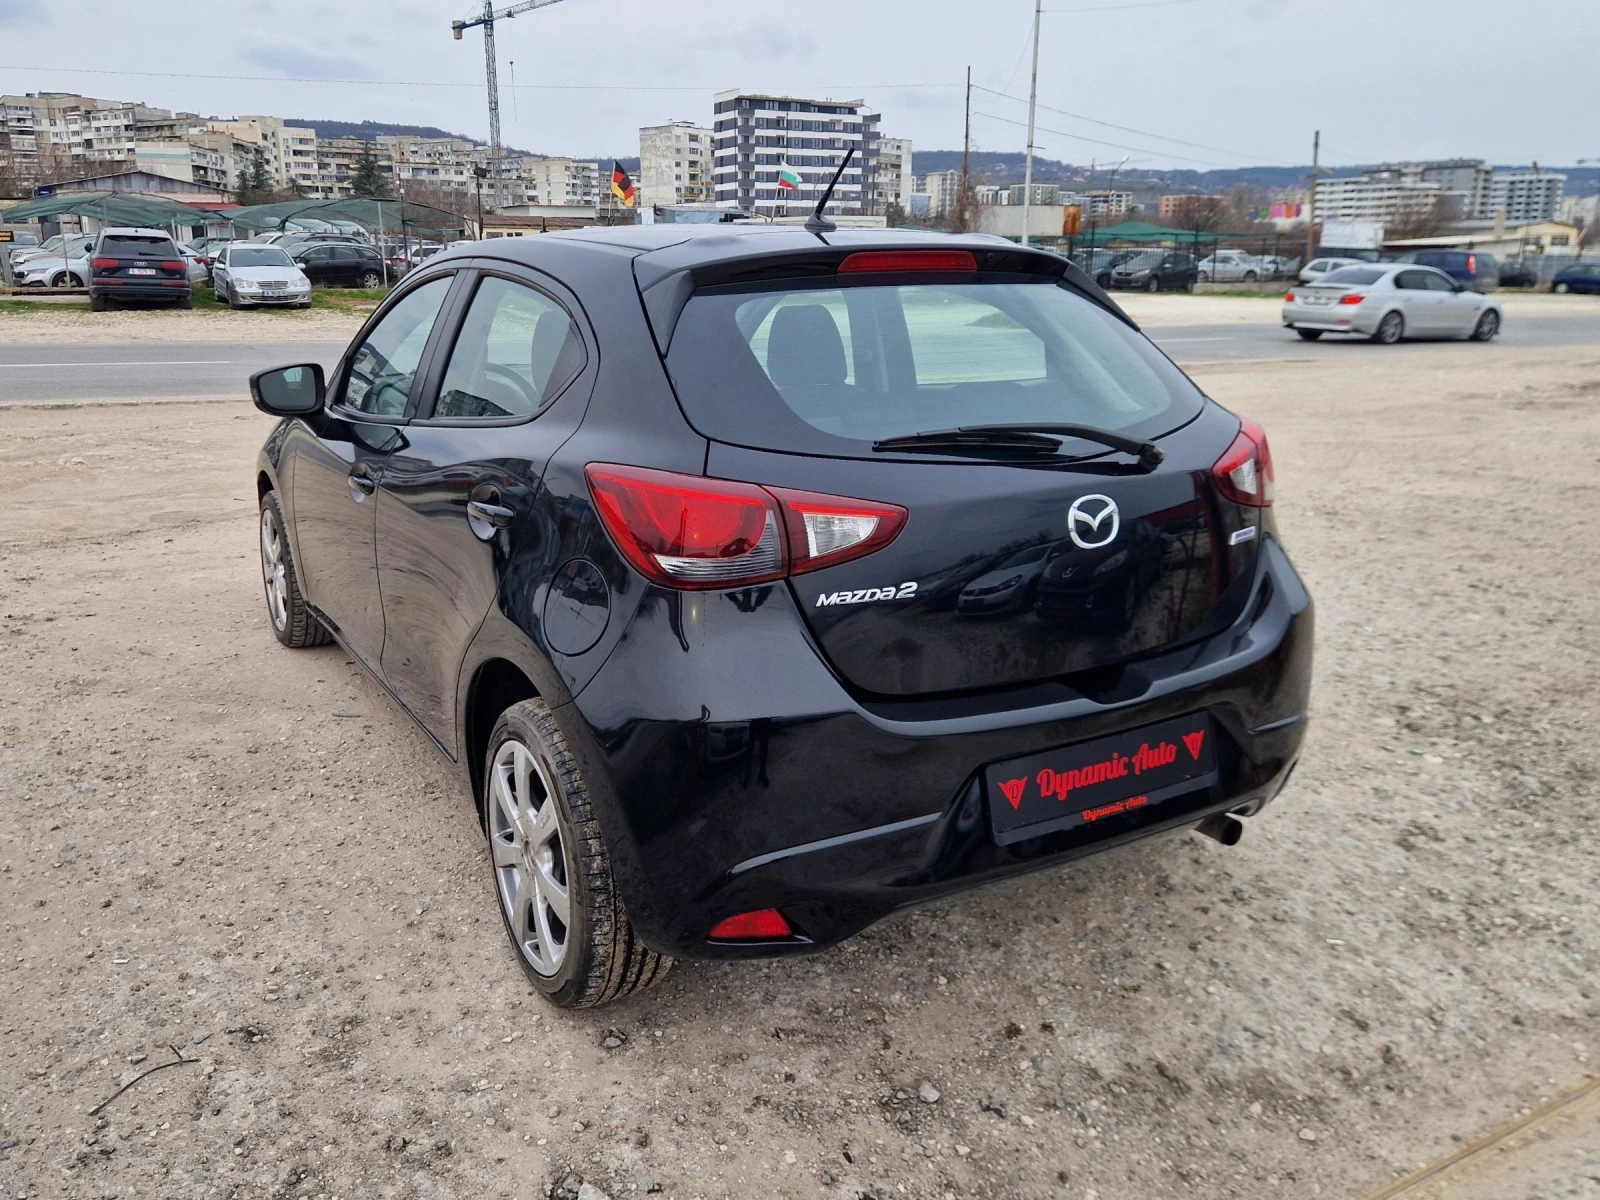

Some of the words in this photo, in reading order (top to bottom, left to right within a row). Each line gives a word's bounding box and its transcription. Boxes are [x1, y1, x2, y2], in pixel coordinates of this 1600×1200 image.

[1036, 752, 1129, 801] Dynamic
[1131, 741, 1177, 775] Auto
[1081, 803, 1124, 821] Dynamic
[1124, 796, 1148, 809] Auto
